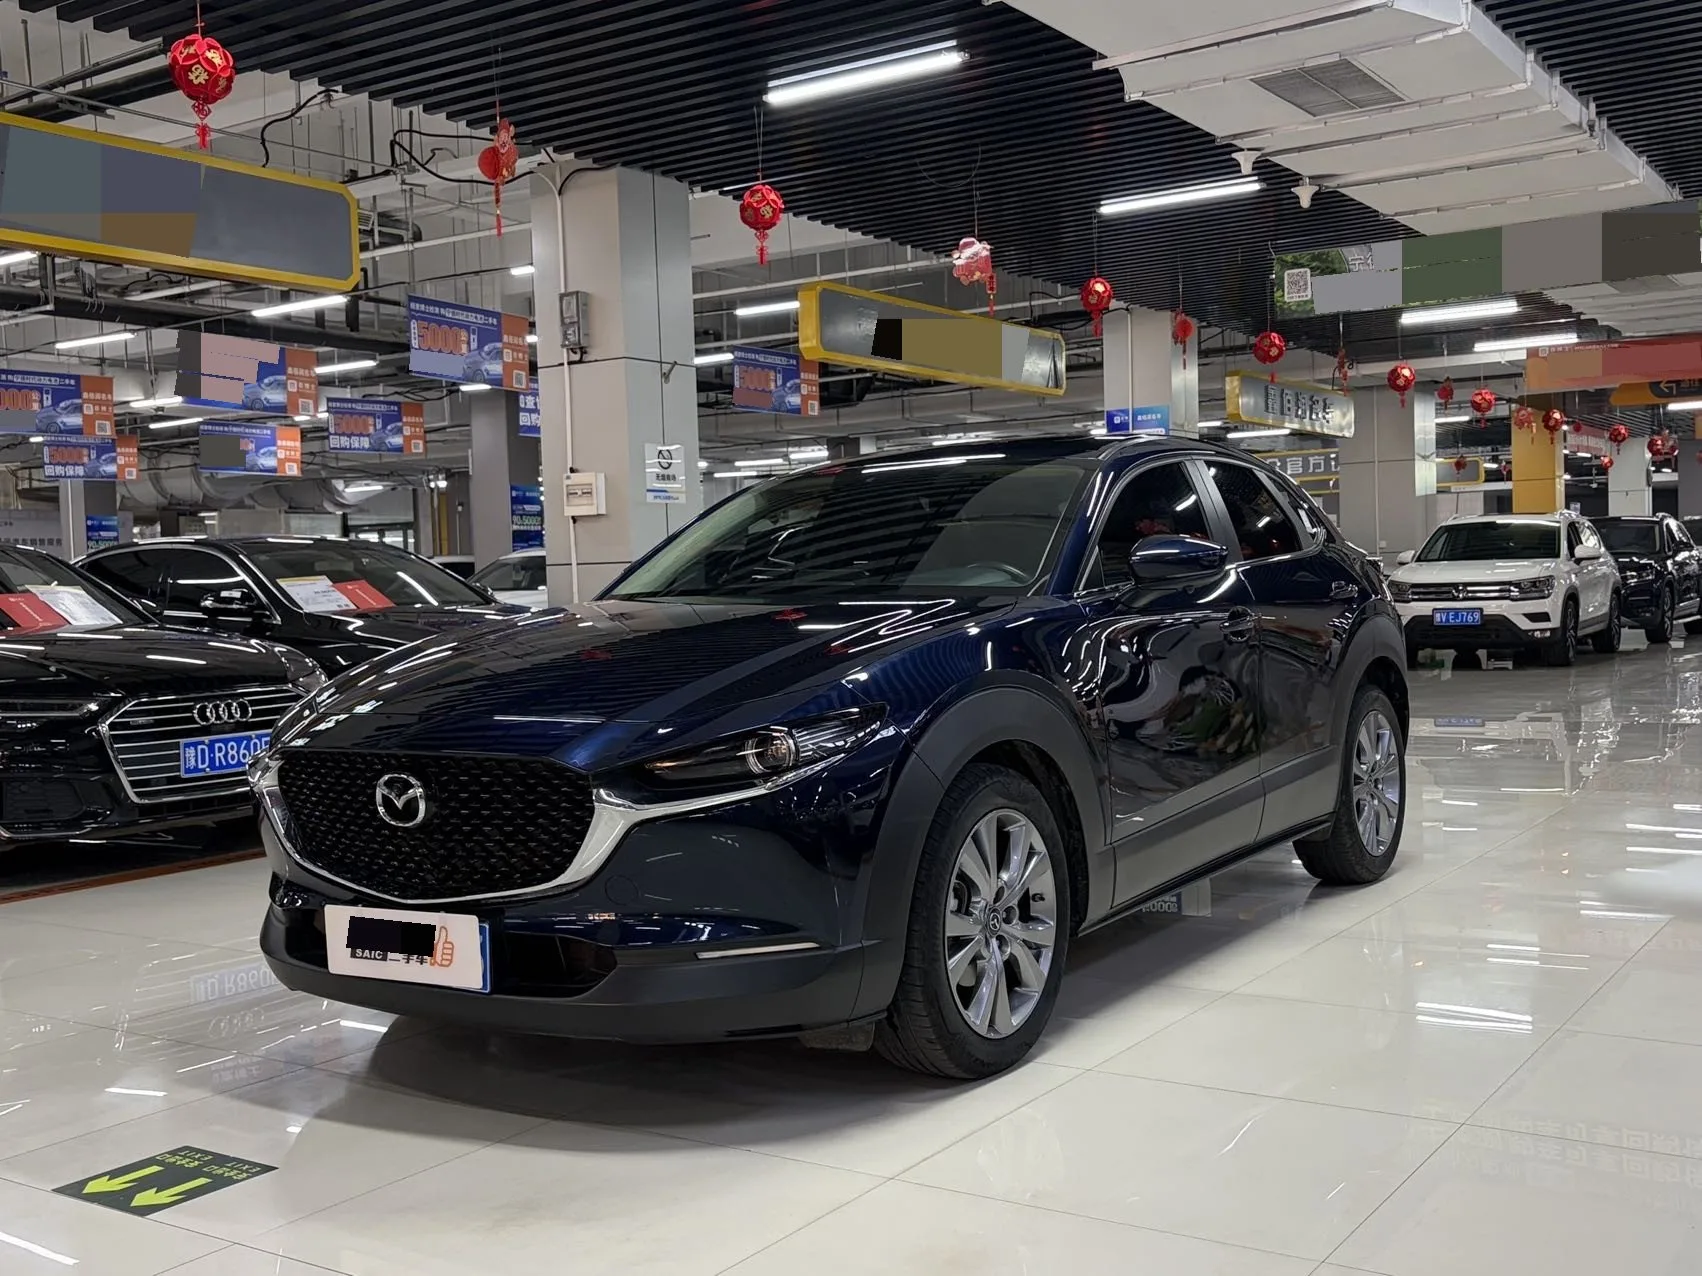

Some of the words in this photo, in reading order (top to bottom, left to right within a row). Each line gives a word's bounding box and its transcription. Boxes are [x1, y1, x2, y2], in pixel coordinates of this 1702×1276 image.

[355, 948, 383, 960] SAIC
[178, 1150, 214, 1161] EXIT
[224, 1161, 262, 1173] EXIT
